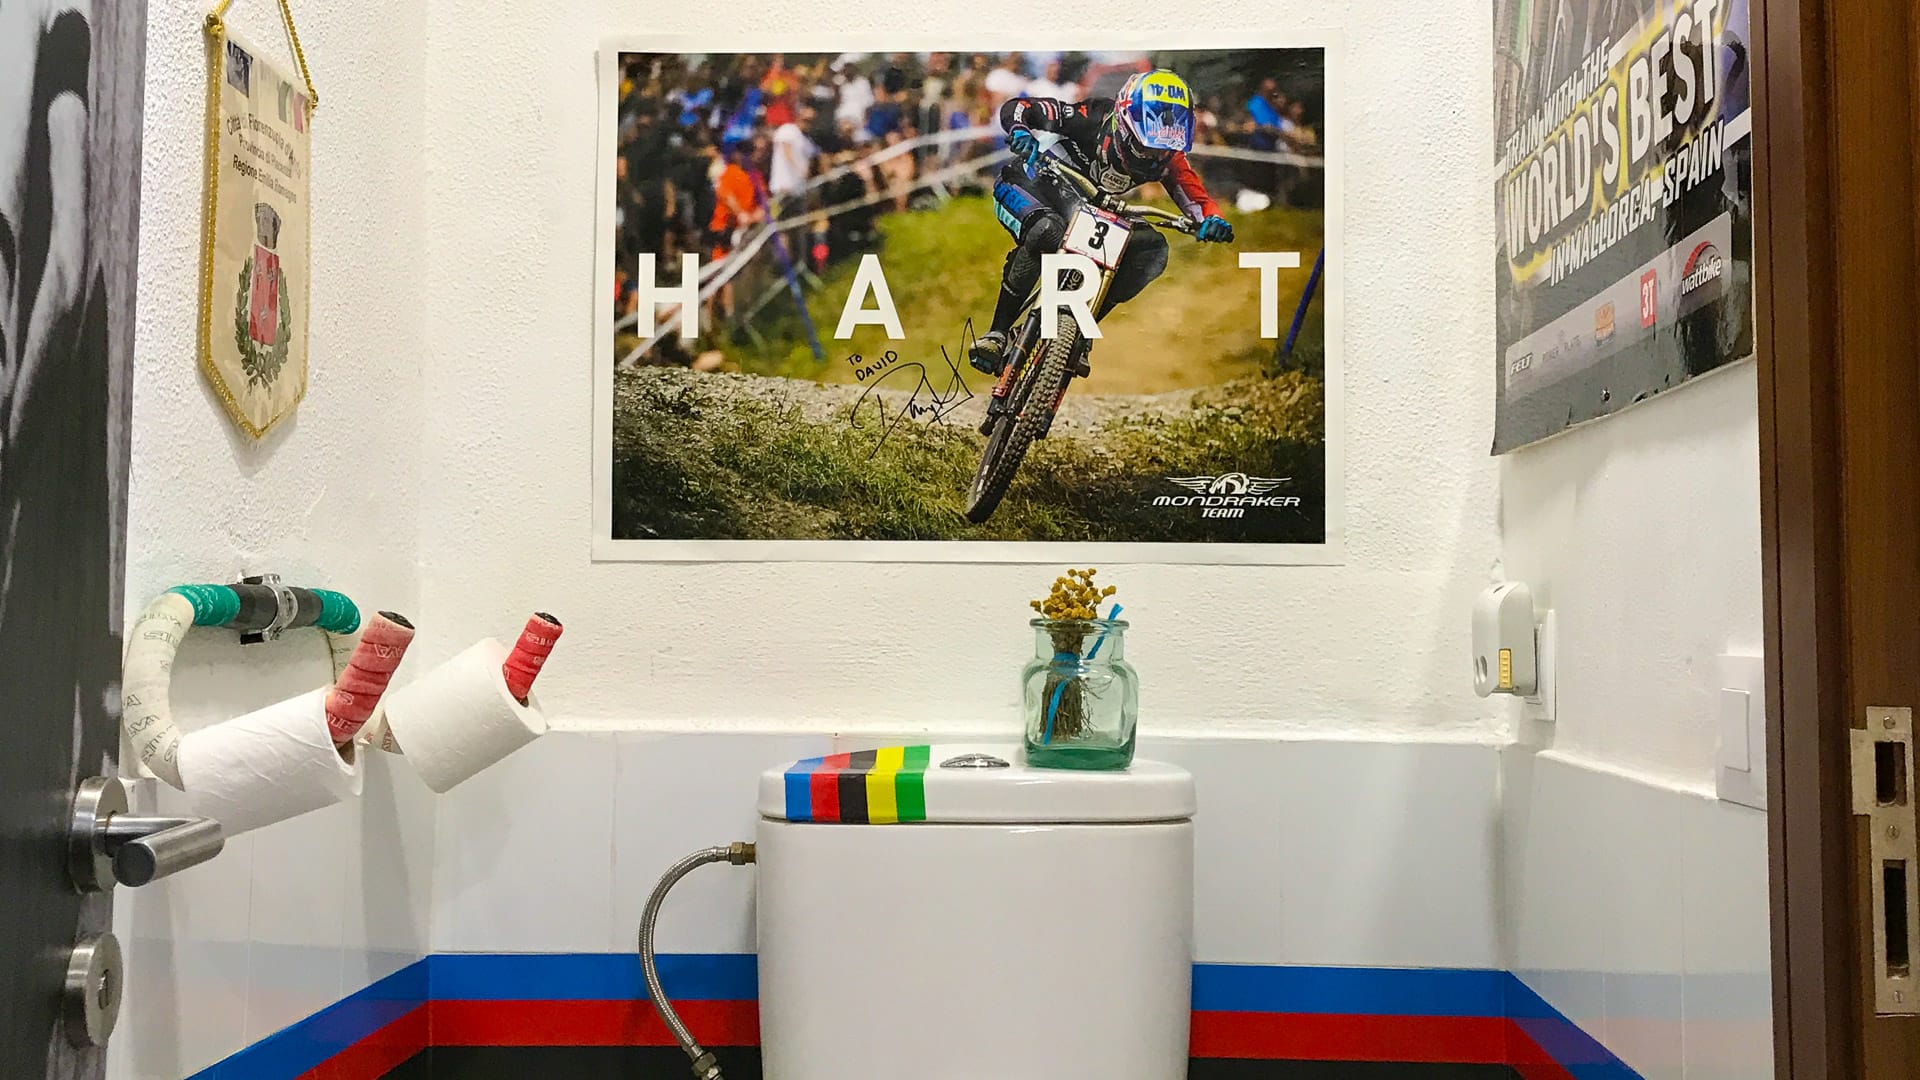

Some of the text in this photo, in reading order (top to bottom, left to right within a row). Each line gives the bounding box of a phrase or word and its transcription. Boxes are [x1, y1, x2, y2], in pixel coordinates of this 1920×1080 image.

[1505, 36, 1610, 175] TRAIN WITH THE
[1509, 0, 1718, 259] WORLD'S BEST
[233, 154, 258, 179] Regione
[1550, 242, 1566, 287] IN
[1663, 120, 1725, 208] SPAIN
[1088, 221, 1110, 250] 3
[1681, 255, 1722, 295] wattbike
[1642, 277, 1655, 319] 3T
[855, 350, 898, 381] DAVID
[1510, 352, 1533, 375] FELT
[1152, 495, 1301, 507] MONDRAKER
[1201, 507, 1245, 518] TEAM
